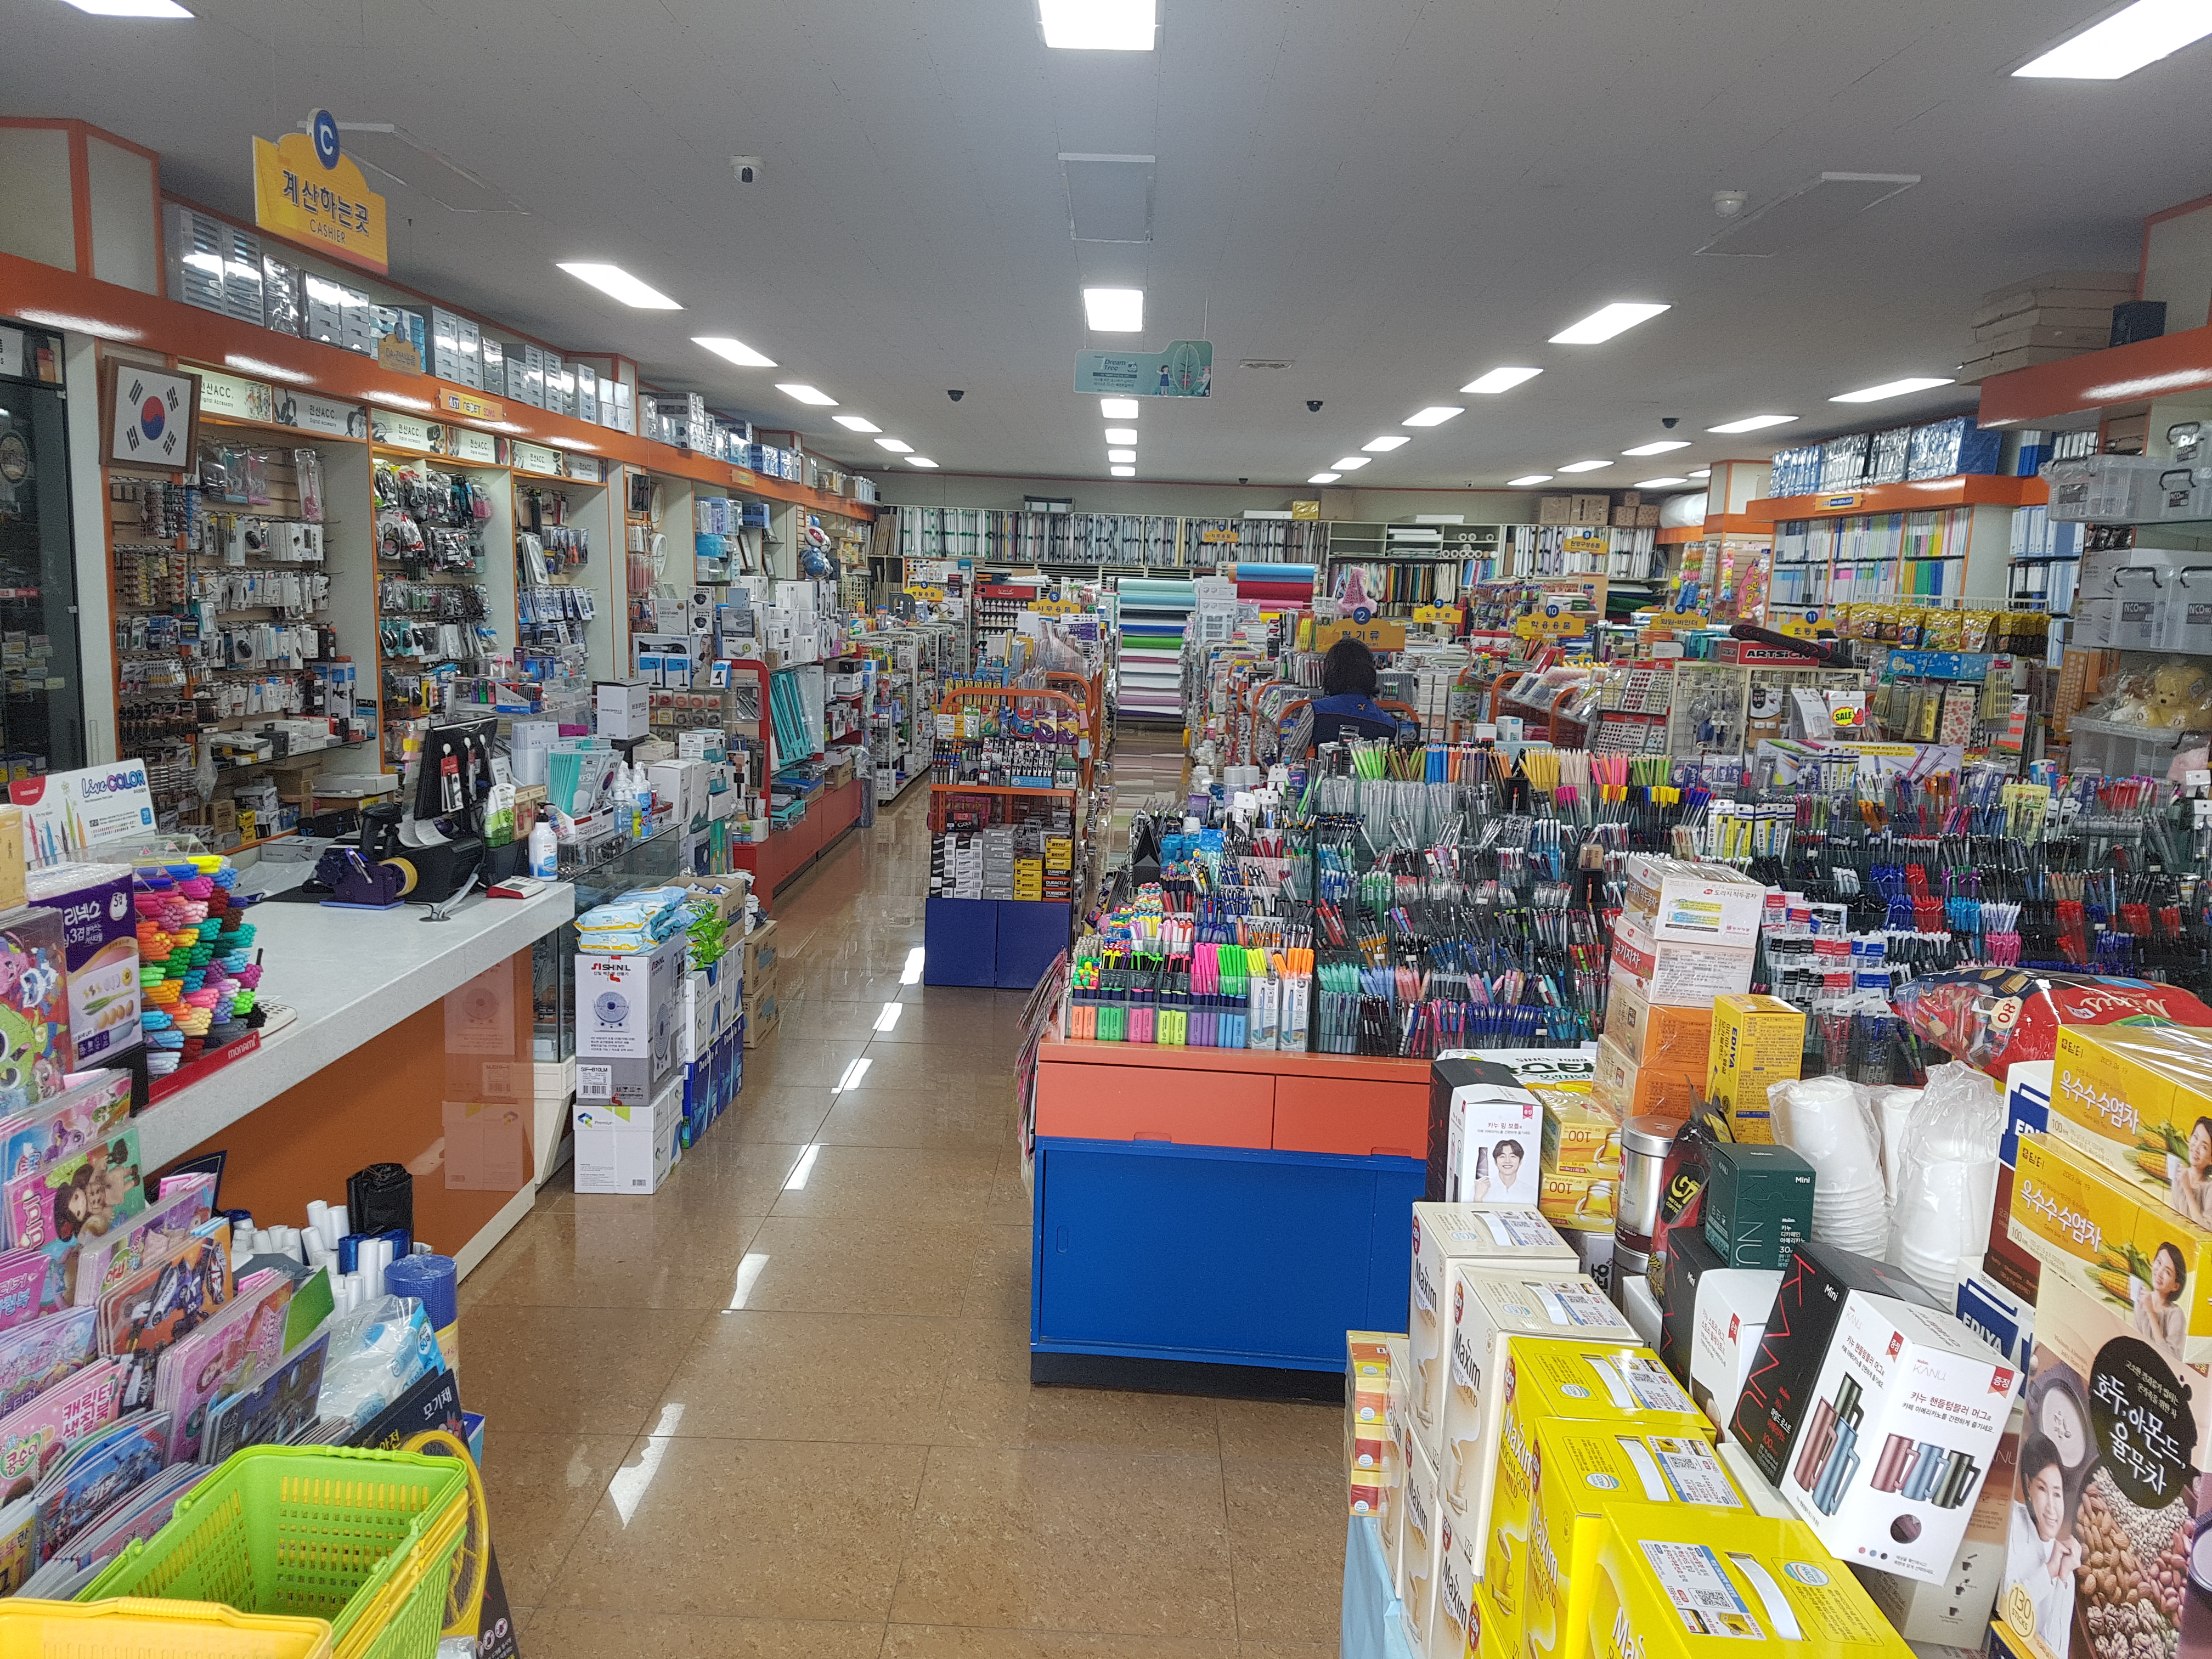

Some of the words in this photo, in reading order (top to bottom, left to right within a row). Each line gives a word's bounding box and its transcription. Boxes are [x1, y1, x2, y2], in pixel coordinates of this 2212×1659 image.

[319, 125, 334, 156] C
[283, 169, 369, 236] 계산하는곳
[310, 218, 347, 245] CASHIER
[1358, 611, 1365, 621] 2
[1808, 613, 1816, 622] 11
[1835, 711, 1854, 721] SALE
[107, 770, 145, 792] COLOR
[578, 772, 595, 782] KF94
[64, 900, 101, 926] 리넥스
[1613, 942, 1641, 969] 구기자차
[227, 1034, 257, 1060] monami
[1728, 1026, 1738, 1069] EDIYA
[1568, 1130, 1592, 1143] 100
[2052, 1118, 2063, 1133] 100
[1549, 1181, 1573, 1194] 100
[2012, 1227, 2022, 1242] 100
[1414, 1257, 1437, 1312] Maxim
[1686, 1271, 1696, 1287] Mini
[1824, 1283, 1839, 1302] Mini
[1847, 1334, 1855, 1346] 카누
[1890, 1338, 1900, 1352] 증정
[1962, 1312, 2002, 1352] EDIYA
[1453, 1327, 1481, 1392] Maxim
[1912, 1364, 1946, 1381] KANU.
[1994, 1375, 2010, 1389] 증정
[61, 1379, 116, 1422] 캐릭터
[423, 1386, 453, 1421] 모기채
[1910, 1391, 1927, 1404] 카누
[1929, 1397, 1970, 1416] 핸들텀블러
[61, 1400, 111, 1440] 색칠북
[1901, 1402, 1914, 1412] 카페
[1915, 1406, 1948, 1421] 아메리카노를
[1948, 1414, 1971, 1427] 간편하게
[1762, 1432, 1773, 1449] 100
[4, 1441, 40, 1476] 콩순이
[2108, 1421, 2167, 1496] 율무차
[1504, 1469, 1519, 1499] MILD
[1407, 1471, 1428, 1537] Maxim
[1464, 1535, 1473, 1558] 170
[1531, 1497, 1559, 1590] Maxim
[1443, 1556, 1467, 1631] Maxim
[1542, 1576, 1556, 1609] GOLD
[2014, 1587, 2032, 1620] 130
[2012, 1607, 2029, 1631] STICKS
